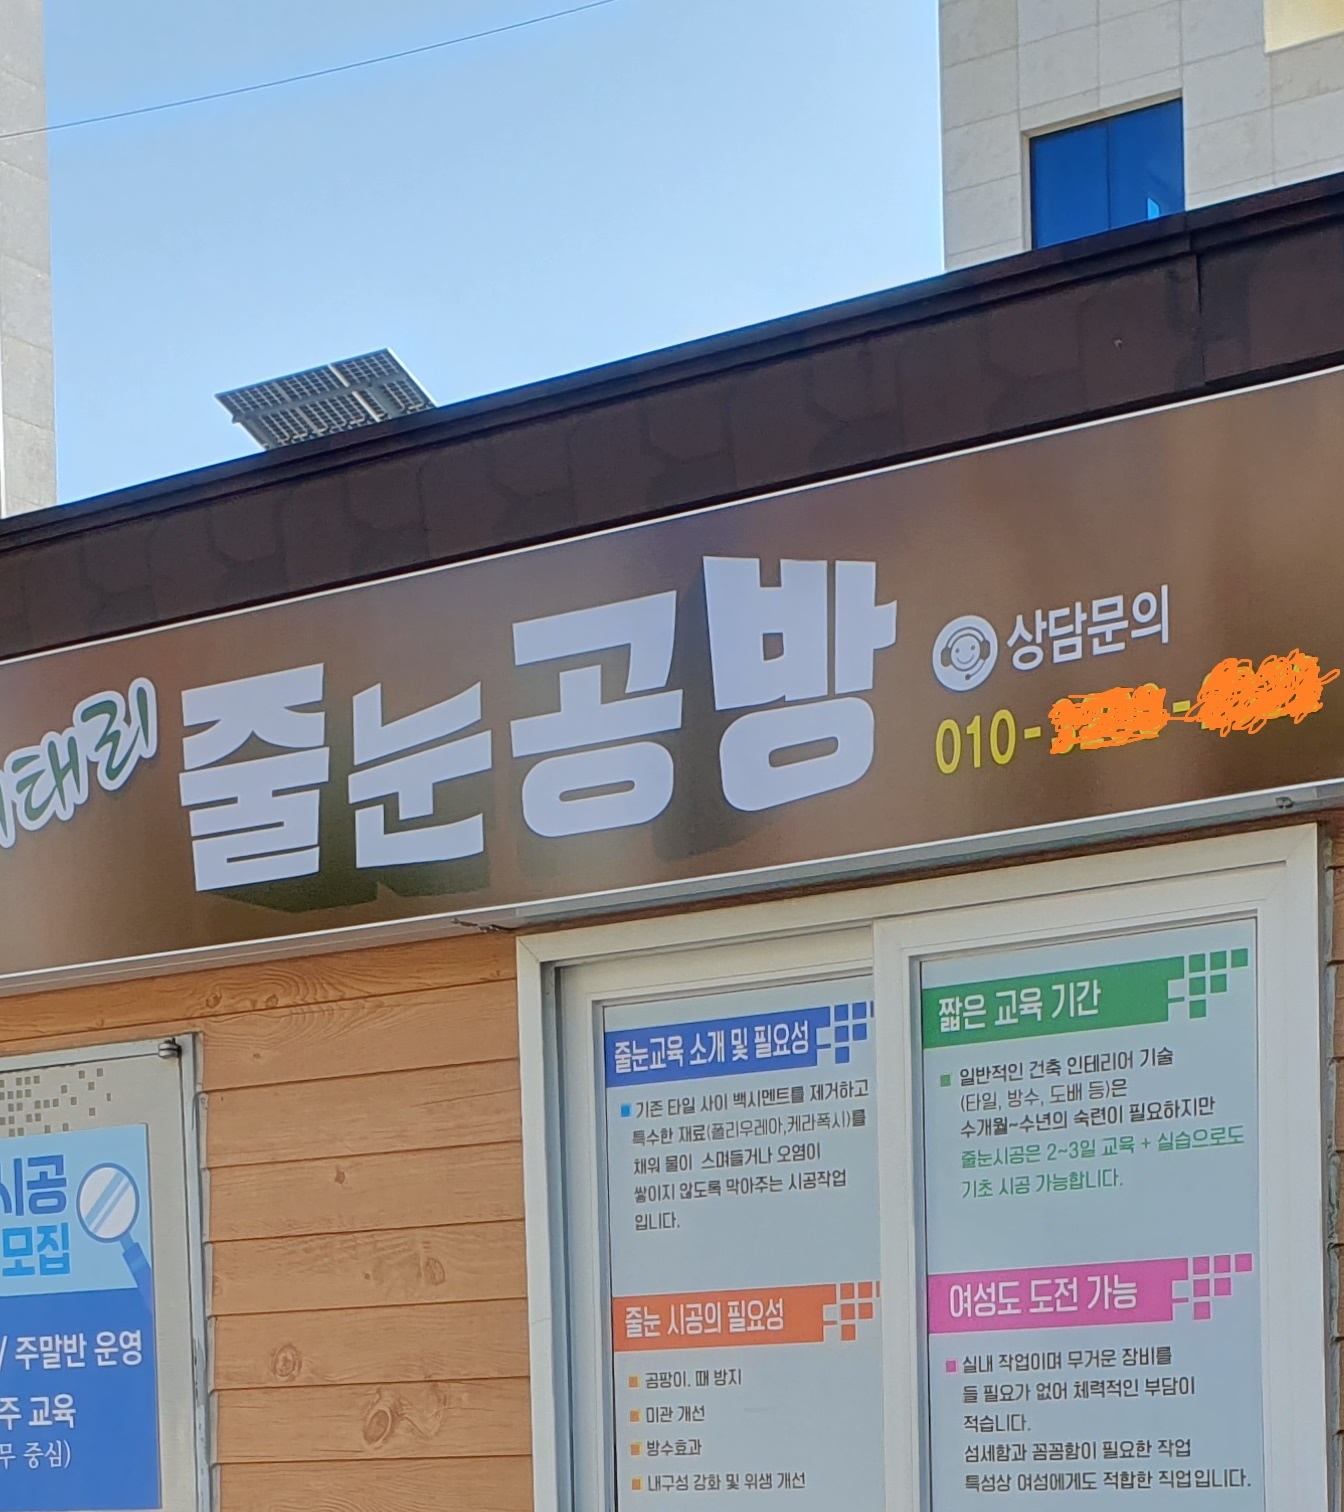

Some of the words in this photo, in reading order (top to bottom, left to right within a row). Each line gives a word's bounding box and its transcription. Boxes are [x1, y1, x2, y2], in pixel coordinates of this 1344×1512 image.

[1006, 584, 1170, 671] 상담문의
[179, 555, 897, 892] 줄눈공방
[939, 994, 987, 1033] 짧은
[995, 988, 1043, 1026] 교육
[1052, 979, 1101, 1019] 기간
[614, 1034, 683, 1073] 줄눈교육
[690, 1030, 725, 1065] 소개
[731, 1027, 748, 1060] 및
[754, 1021, 809, 1058] 필요성
[960, 1062, 1023, 1086] 일반적인
[1029, 1059, 1061, 1080] 건축
[1067, 1051, 1134, 1075] 인테리어
[1139, 1047, 1174, 1067] 기술
[635, 1101, 663, 1119] 기존
[668, 1097, 695, 1115] 타일
[700, 1094, 728, 1112] 사이
[733, 1086, 804, 1109] 백시멘트를
[810, 1079, 869, 1101] 제거하고
[960, 1091, 1002, 1112] (타일,
[1008, 1086, 1044, 1108] 방수,
[1050, 1083, 1082, 1104] 도배
[1088, 1078, 1128, 1100] 등)은
[960, 1109, 1068, 1139] 수개월~수년의
[1073, 1105, 1123, 1127] 숙련이
[1129, 1096, 1215, 1123] 필요하지만
[633, 1127, 673, 1146] 특수한
[962, 1143, 1041, 1169] 줄눈시공은
[1047, 1139, 1095, 1160] 2~3일
[1101, 1136, 1135, 1156] 교육
[1157, 1125, 1244, 1152] 실습으로도
[634, 1157, 660, 1175] 채워
[665, 1154, 692, 1173] 물이
[701, 1147, 772, 1170] 스며들거나
[778, 1143, 820, 1163] 오염이
[635, 1184, 675, 1203] 쌓이지
[680, 1180, 721, 1199] 않도록
[727, 1176, 783, 1196] 막아주는
[789, 1169, 846, 1190] 시공작업
[962, 1179, 993, 1198] 기초
[999, 1176, 1030, 1195] 시공
[1035, 1168, 1123, 1193] 가능합니다.
[635, 1212, 680, 1231] 입니다.
[2, 1222, 71, 1277] 모집
[949, 1281, 1022, 1317] 여성도
[1029, 1277, 1078, 1313] 도전
[1087, 1274, 1137, 1310] 가능
[625, 1306, 661, 1338] 줄눈
[667, 1302, 721, 1336] 시공의
[727, 1298, 784, 1332] 필요성
[15, 1334, 87, 1371] 주말반
[94, 1330, 144, 1367] 운영
[962, 1354, 993, 1374] 실내
[998, 1352, 1062, 1371] 작업이며
[1068, 1349, 1117, 1369] 무거운
[1122, 1346, 1172, 1366] 장비를
[695, 1370, 709, 1387] 때
[714, 1369, 742, 1385] 방지
[963, 1385, 978, 1403] 들
[983, 1383, 1030, 1403] 필요가
[1036, 1382, 1067, 1401] 없어
[1073, 1379, 1138, 1399] 체력적인
[1144, 1376, 1195, 1397] 부담이
[28, 1394, 76, 1428] 교육
[646, 1407, 673, 1423] 미관
[677, 1405, 705, 1422] 개선
[963, 1414, 1031, 1433] 적습니다.
[24, 1439, 72, 1471] 중심)
[647, 1439, 702, 1456] 방수효과
[964, 1443, 1027, 1463] 섬세함과
[1032, 1441, 1097, 1461] 꼼꼼함이
[1102, 1439, 1152, 1459] 필요한
[1157, 1439, 1191, 1458] 작업
[648, 1475, 689, 1492] 내구성
[693, 1474, 721, 1491] 강화
[726, 1474, 740, 1490] 및
[744, 1473, 772, 1489] 위생
[777, 1472, 805, 1489] 개선
[964, 1473, 1011, 1492] 특성상
[1018, 1472, 1097, 1491] 여성에게도
[1103, 1470, 1152, 1490] 적합한
